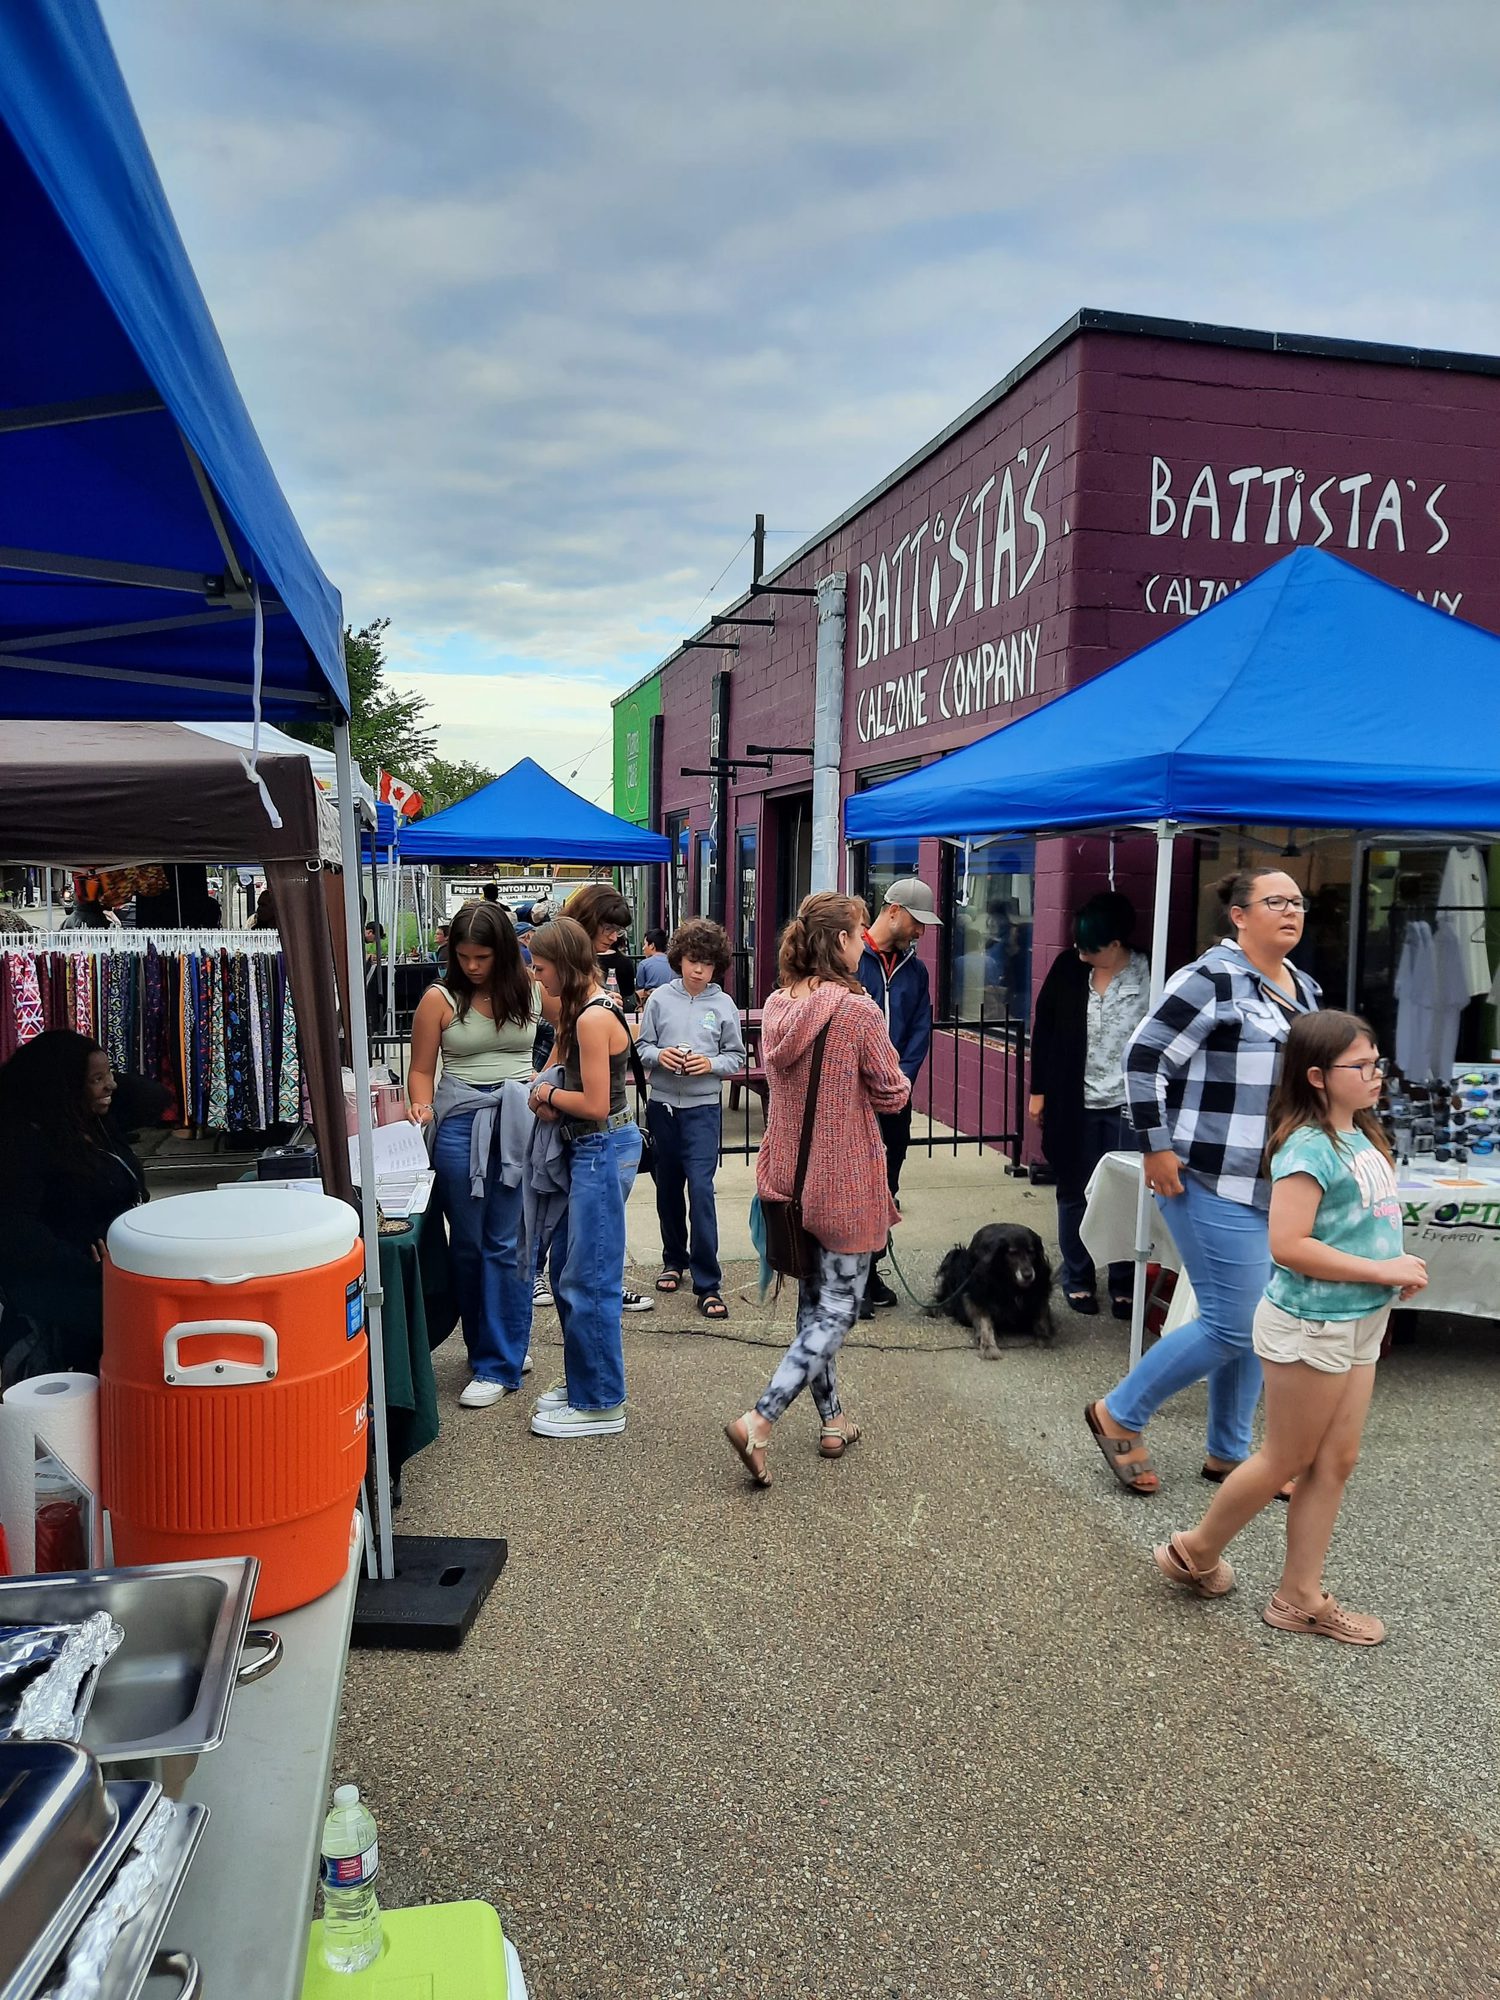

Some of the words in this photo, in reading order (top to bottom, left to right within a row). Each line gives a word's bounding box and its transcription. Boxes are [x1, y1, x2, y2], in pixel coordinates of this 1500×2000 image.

[1145, 574, 1242, 616] CALZ
[857, 668, 928, 743] CALZONE
[940, 624, 1041, 719] COMPANY
[454, 886, 477, 894] FIRST
[479, 885, 526, 894] EONTON
[527, 884, 550, 893] AUTO
